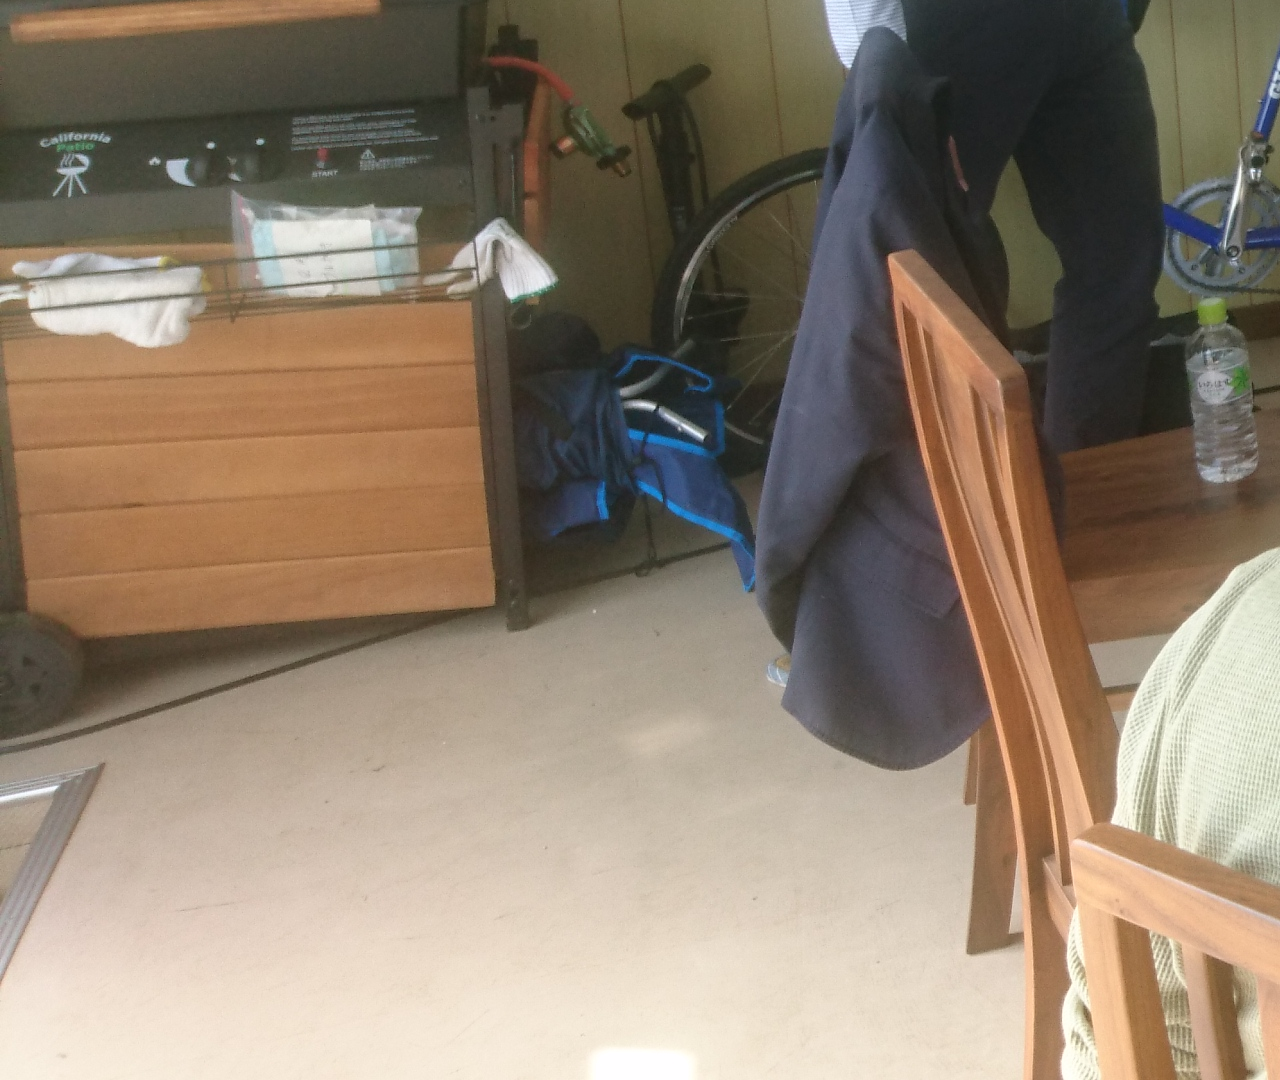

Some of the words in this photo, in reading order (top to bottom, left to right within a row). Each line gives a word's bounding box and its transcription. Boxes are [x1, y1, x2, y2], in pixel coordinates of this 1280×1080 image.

[39, 131, 112, 148] California
[56, 142, 96, 152] Patio
[312, 169, 339, 178] START
